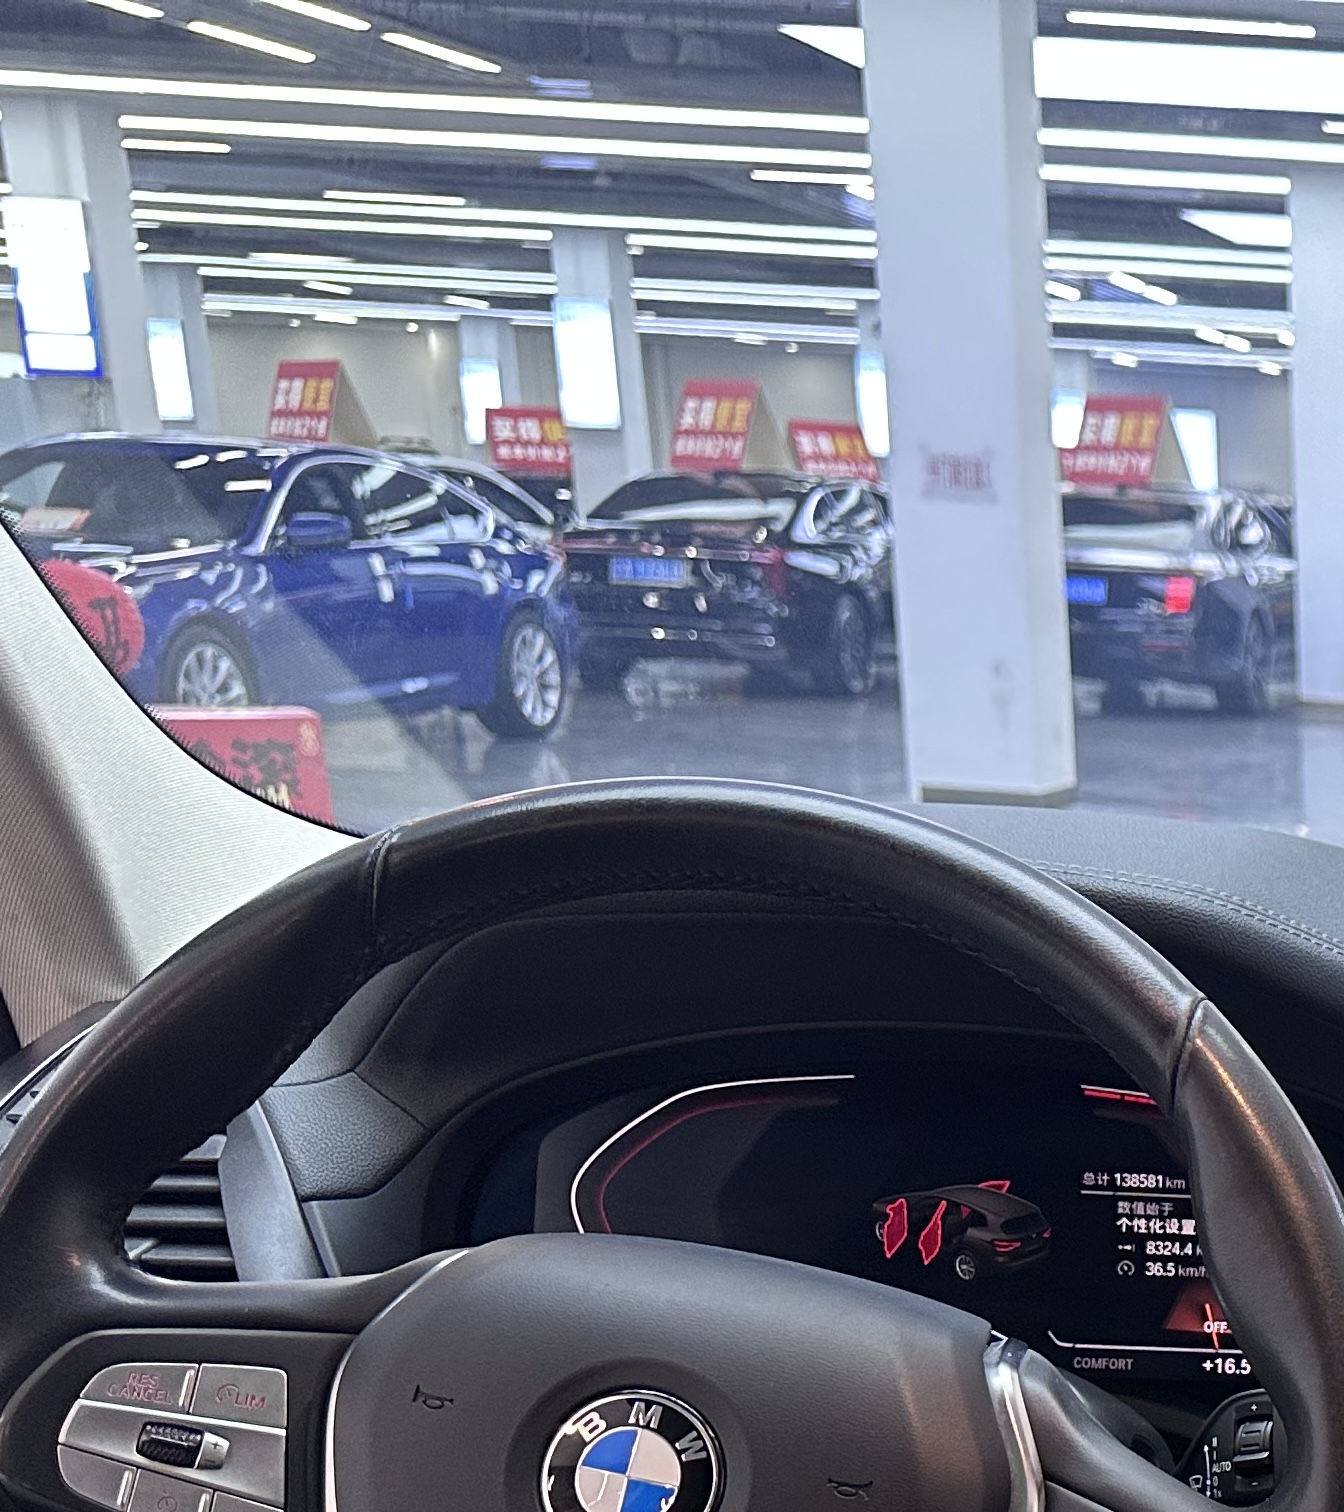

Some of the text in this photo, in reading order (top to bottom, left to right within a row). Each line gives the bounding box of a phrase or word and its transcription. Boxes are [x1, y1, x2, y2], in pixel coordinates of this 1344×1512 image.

[491, 416, 566, 444] 买得便
[1082, 1172, 1186, 1189] 总计 138581 km
[1117, 1201, 1174, 1217] 数值始于
[1116, 1218, 1197, 1236] 个性化设置
[1145, 1241, 1193, 1256] 8324.4
[1145, 1262, 1176, 1277] 36.5
[1203, 1321, 1228, 1334] OFF
[1073, 1357, 1134, 1370] COMFORT
[1202, 1358, 1251, 1375] +16.5
[107, 1383, 173, 1406] CANCEL
[234, 1394, 267, 1410] LIM
[577, 1400, 708, 1463] BMW
[1212, 1461, 1232, 1473] AUTO
